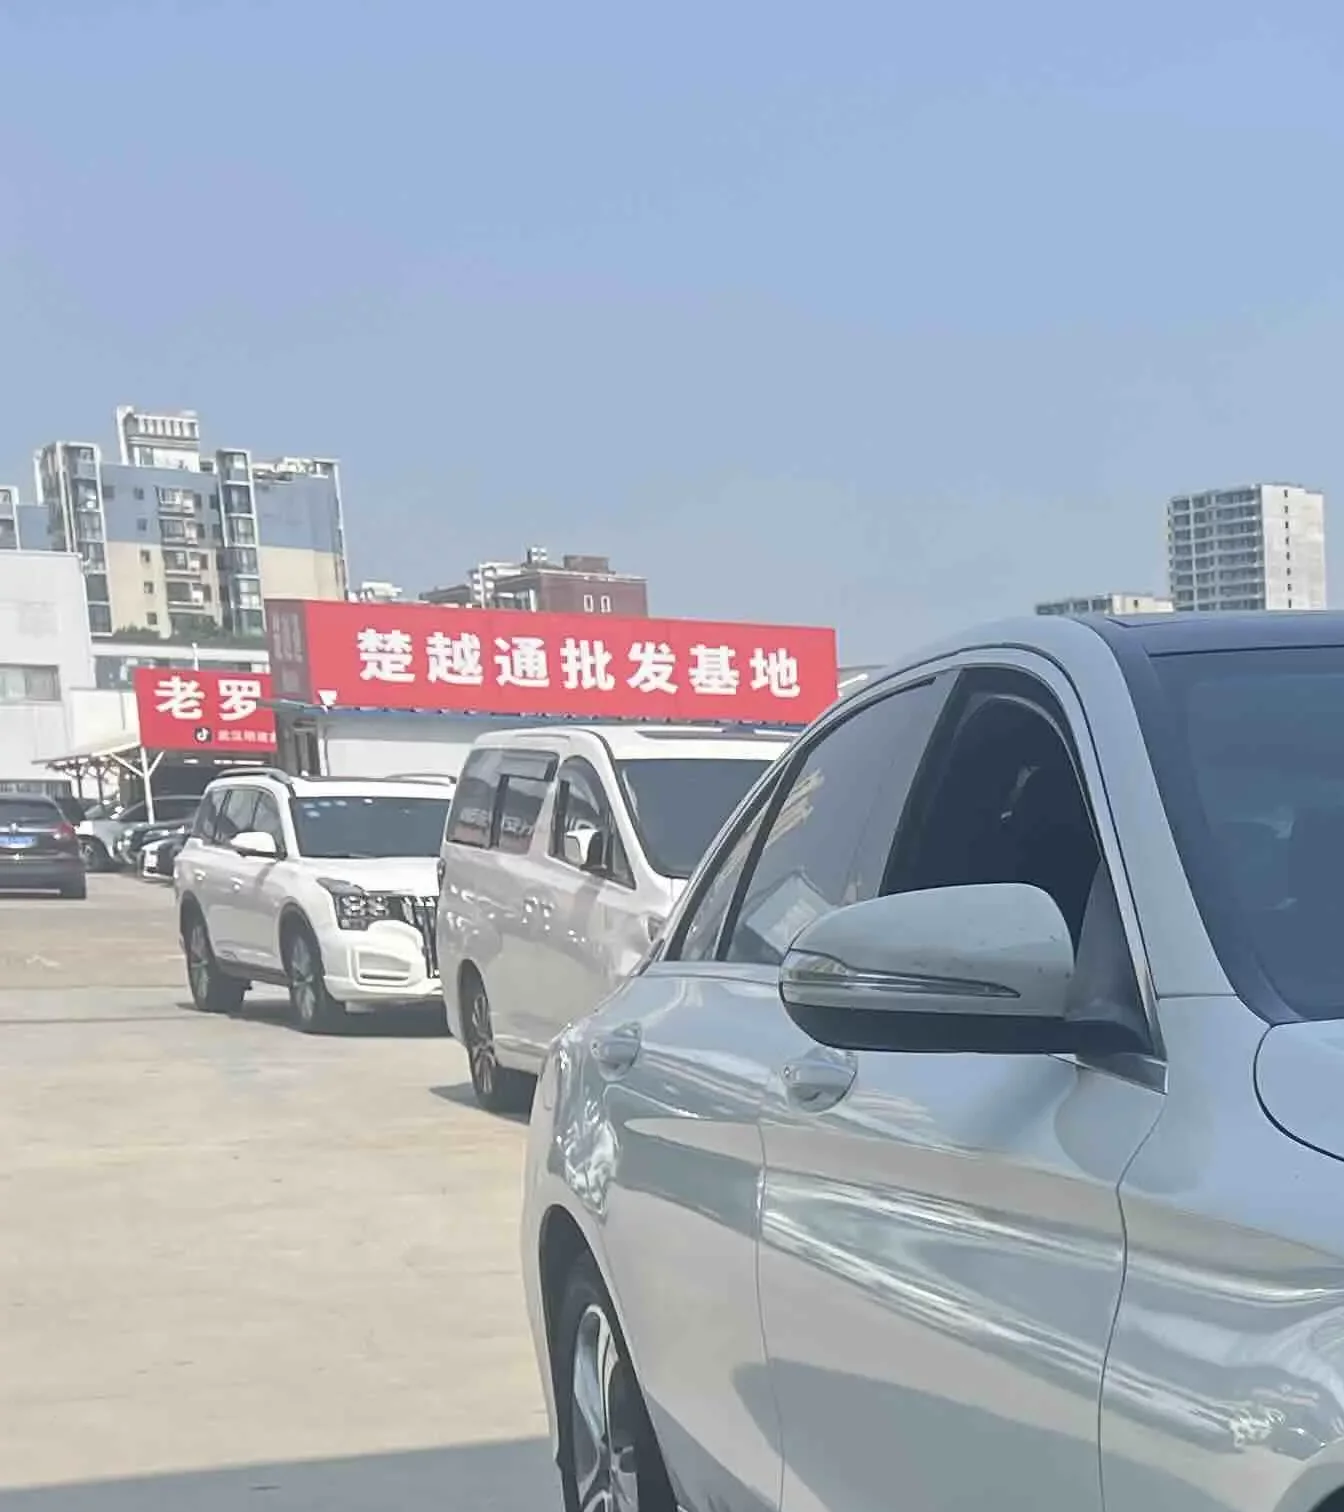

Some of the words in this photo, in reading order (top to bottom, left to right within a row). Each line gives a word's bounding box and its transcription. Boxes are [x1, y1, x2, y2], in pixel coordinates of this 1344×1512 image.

[356, 628, 801, 698] 楚越通批发基地
[153, 676, 261, 721] 老罗
